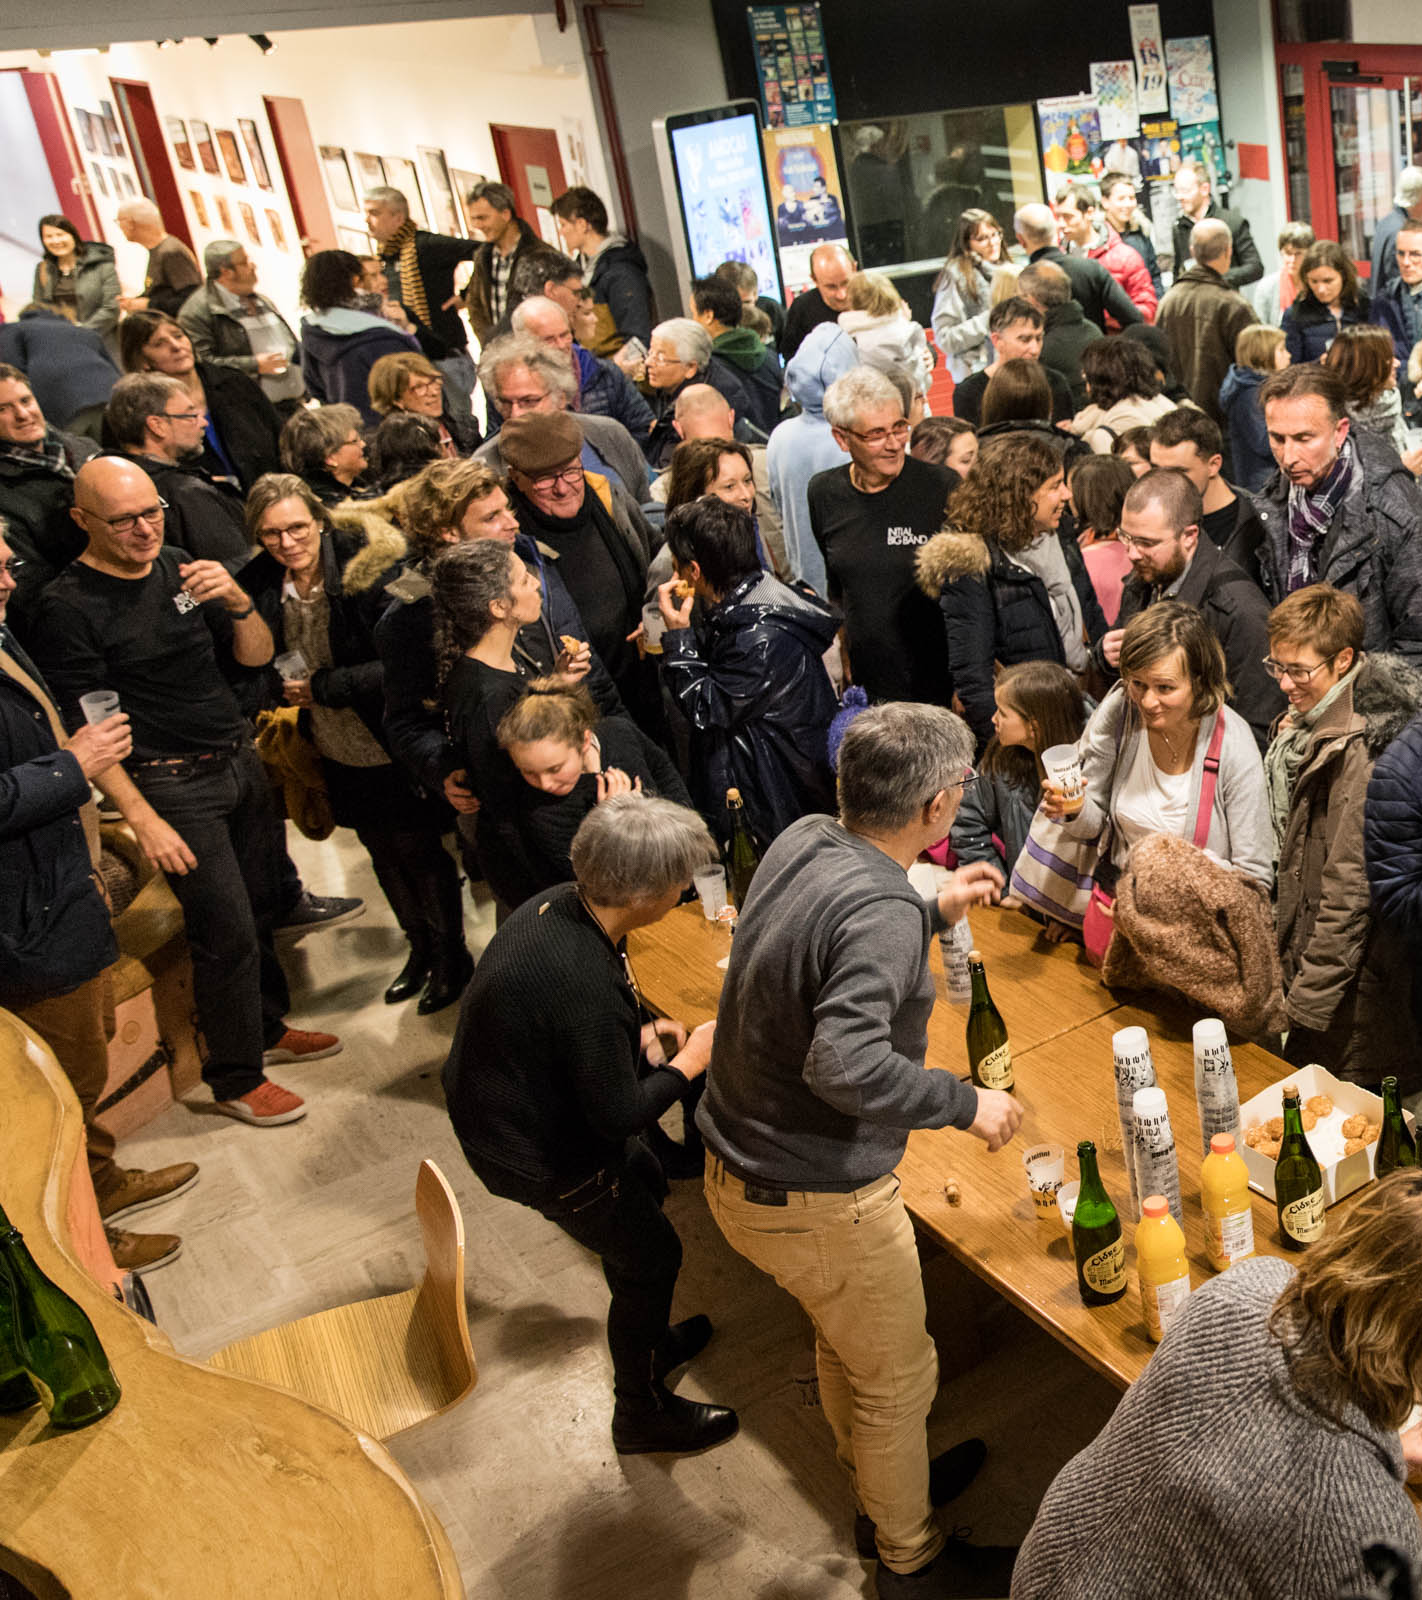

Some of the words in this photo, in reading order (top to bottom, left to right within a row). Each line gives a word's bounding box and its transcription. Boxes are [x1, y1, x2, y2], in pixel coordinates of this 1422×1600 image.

[887, 535, 902, 546] BIG
[902, 535, 928, 545] BAND
[1289, 1197, 1316, 1214] Cidre
[1091, 1246, 1117, 1267] Cidre
